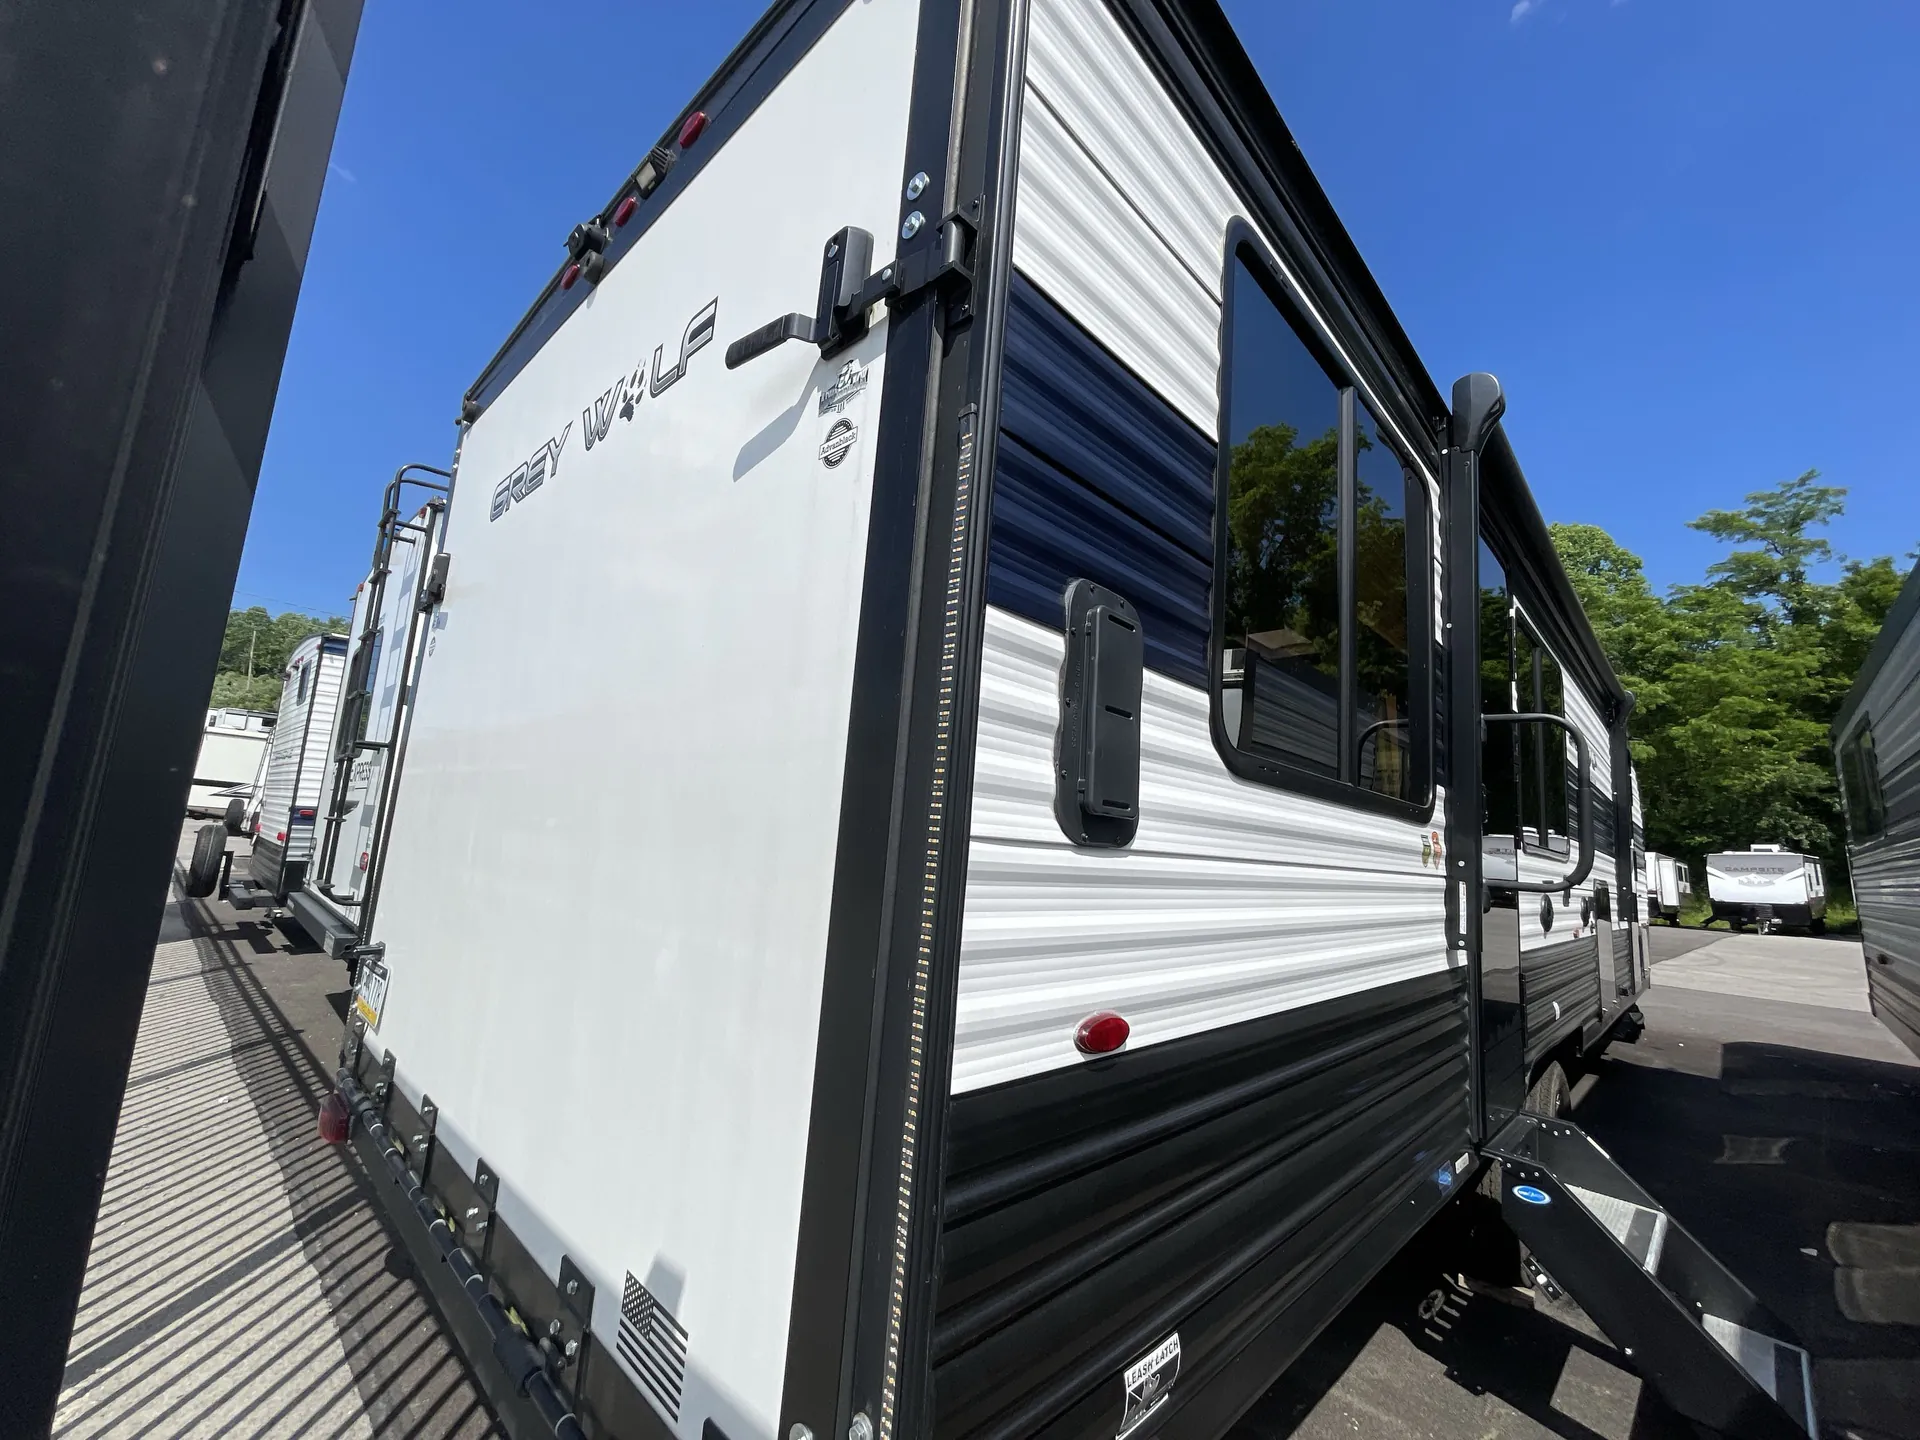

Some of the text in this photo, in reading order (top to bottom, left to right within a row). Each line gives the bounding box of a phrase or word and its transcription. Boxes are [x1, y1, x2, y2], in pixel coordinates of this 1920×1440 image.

[821, 432, 855, 455] Advanblack
[489, 419, 574, 523] GREY
[1126, 1337, 1179, 1388] LEASH LATCH
